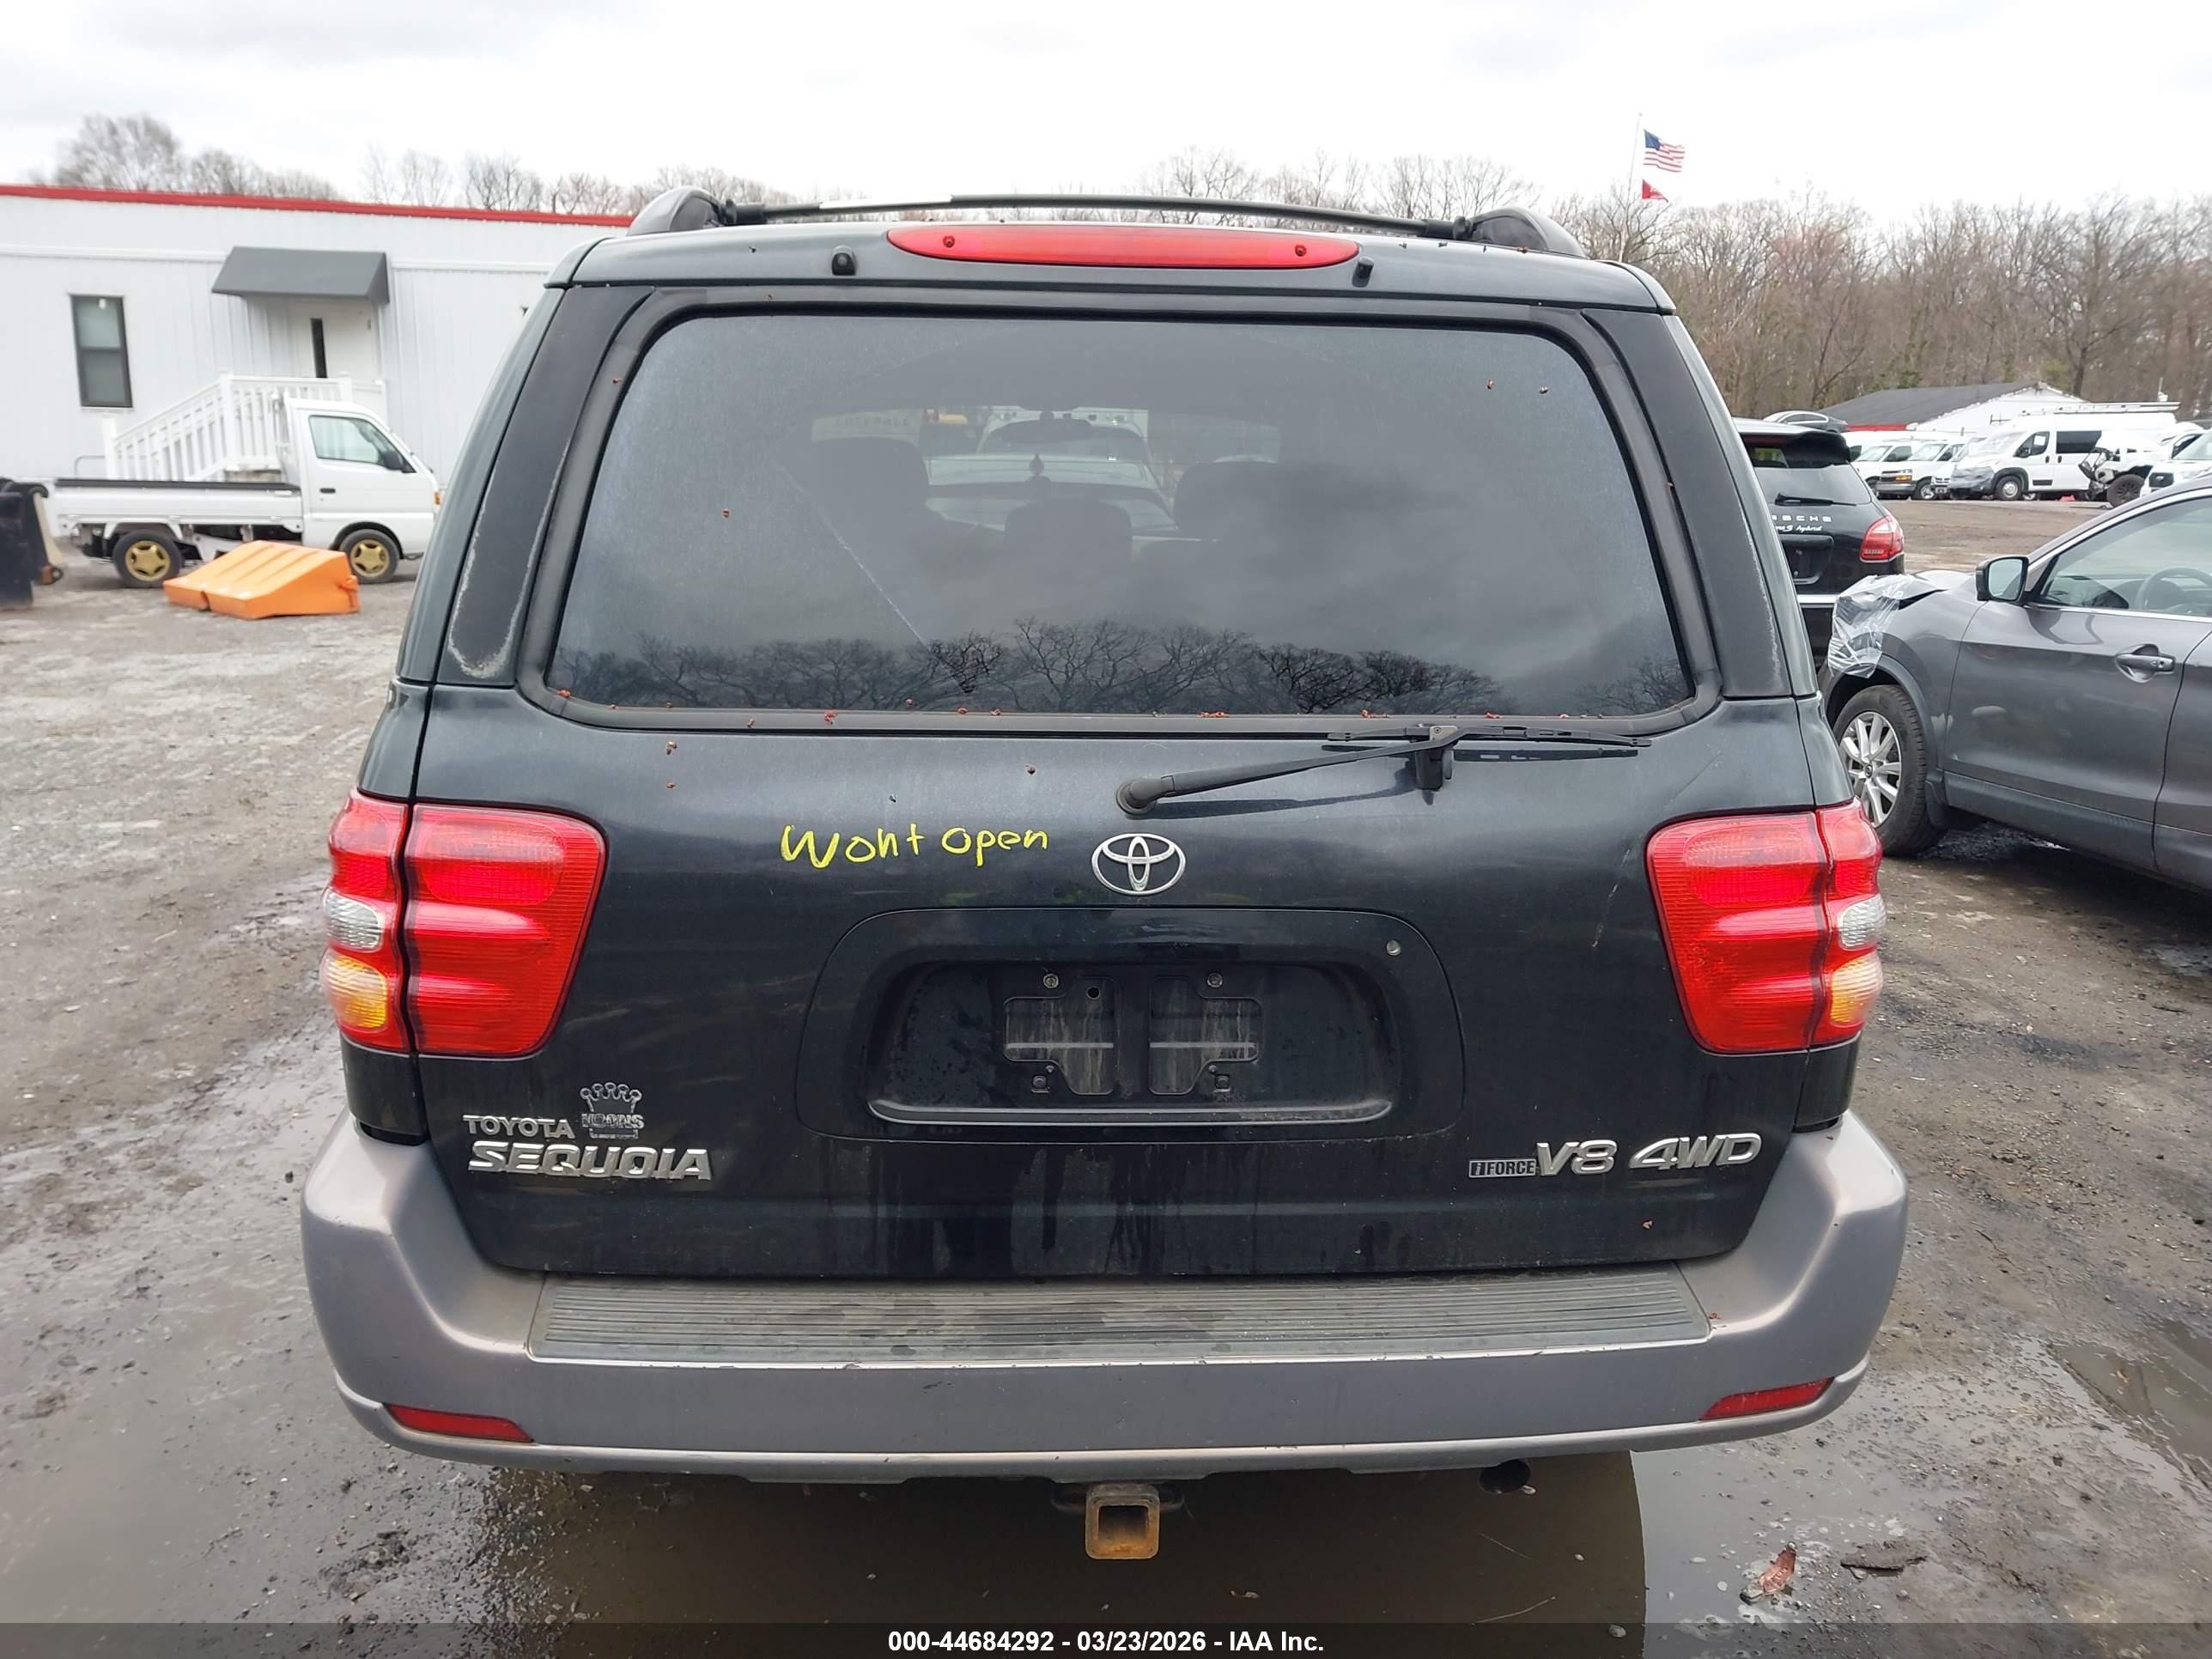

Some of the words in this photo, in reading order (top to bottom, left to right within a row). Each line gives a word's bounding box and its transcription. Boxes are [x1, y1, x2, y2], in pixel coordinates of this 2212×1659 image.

[780, 823, 926, 869] Wont
[462, 1114, 576, 1139] TOYOTA
[468, 1139, 713, 1181] SEQUOIA
[1535, 1139, 1619, 1176] V8
[1628, 1133, 1762, 1170] 4WD
